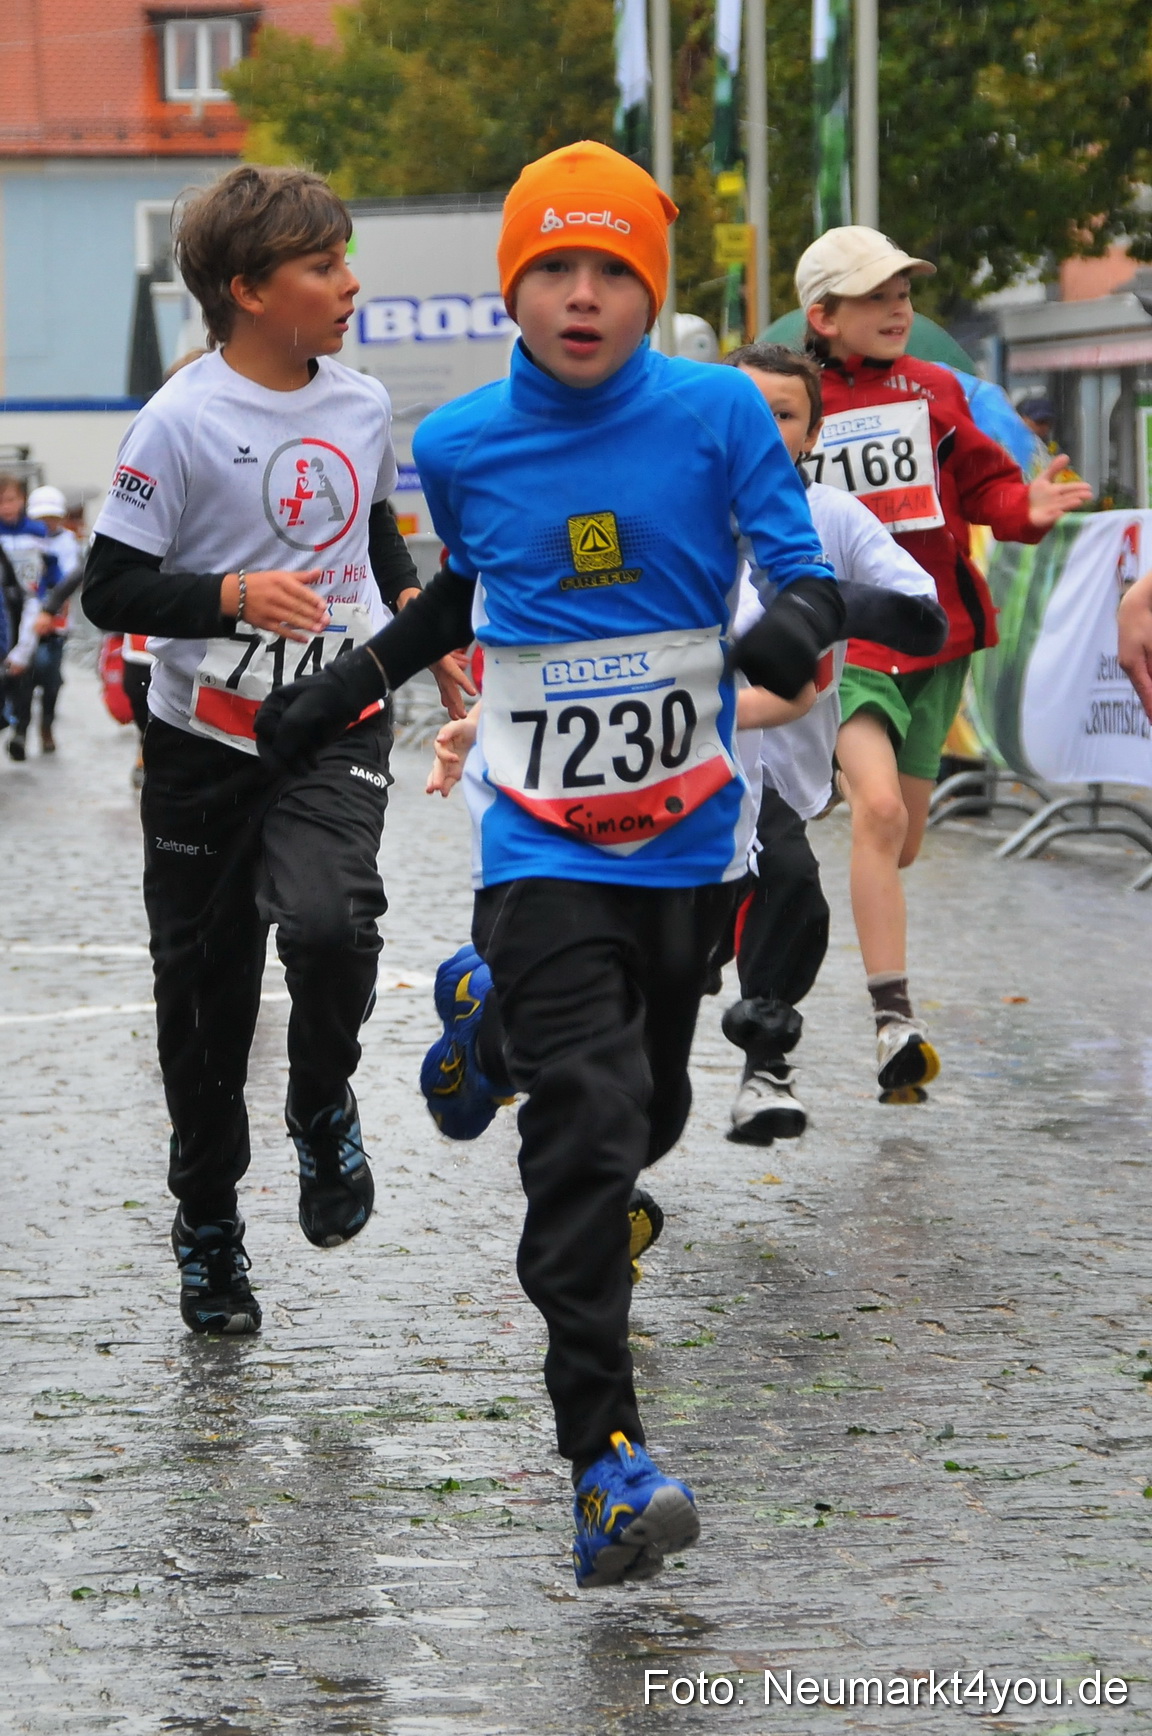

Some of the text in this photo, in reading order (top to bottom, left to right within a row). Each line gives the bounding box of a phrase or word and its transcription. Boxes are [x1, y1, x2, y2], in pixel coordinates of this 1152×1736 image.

[565, 210, 631, 235] odlo
[821, 415, 882, 439] BOCK
[806, 436, 918, 492] 7168
[560, 568, 643, 591] FIREFLY
[542, 651, 652, 686] BOCK
[510, 689, 697, 790] 7230
[350, 765, 382, 788] JAKO
[564, 804, 657, 836] Simon
[204, 844, 217, 856] L.
